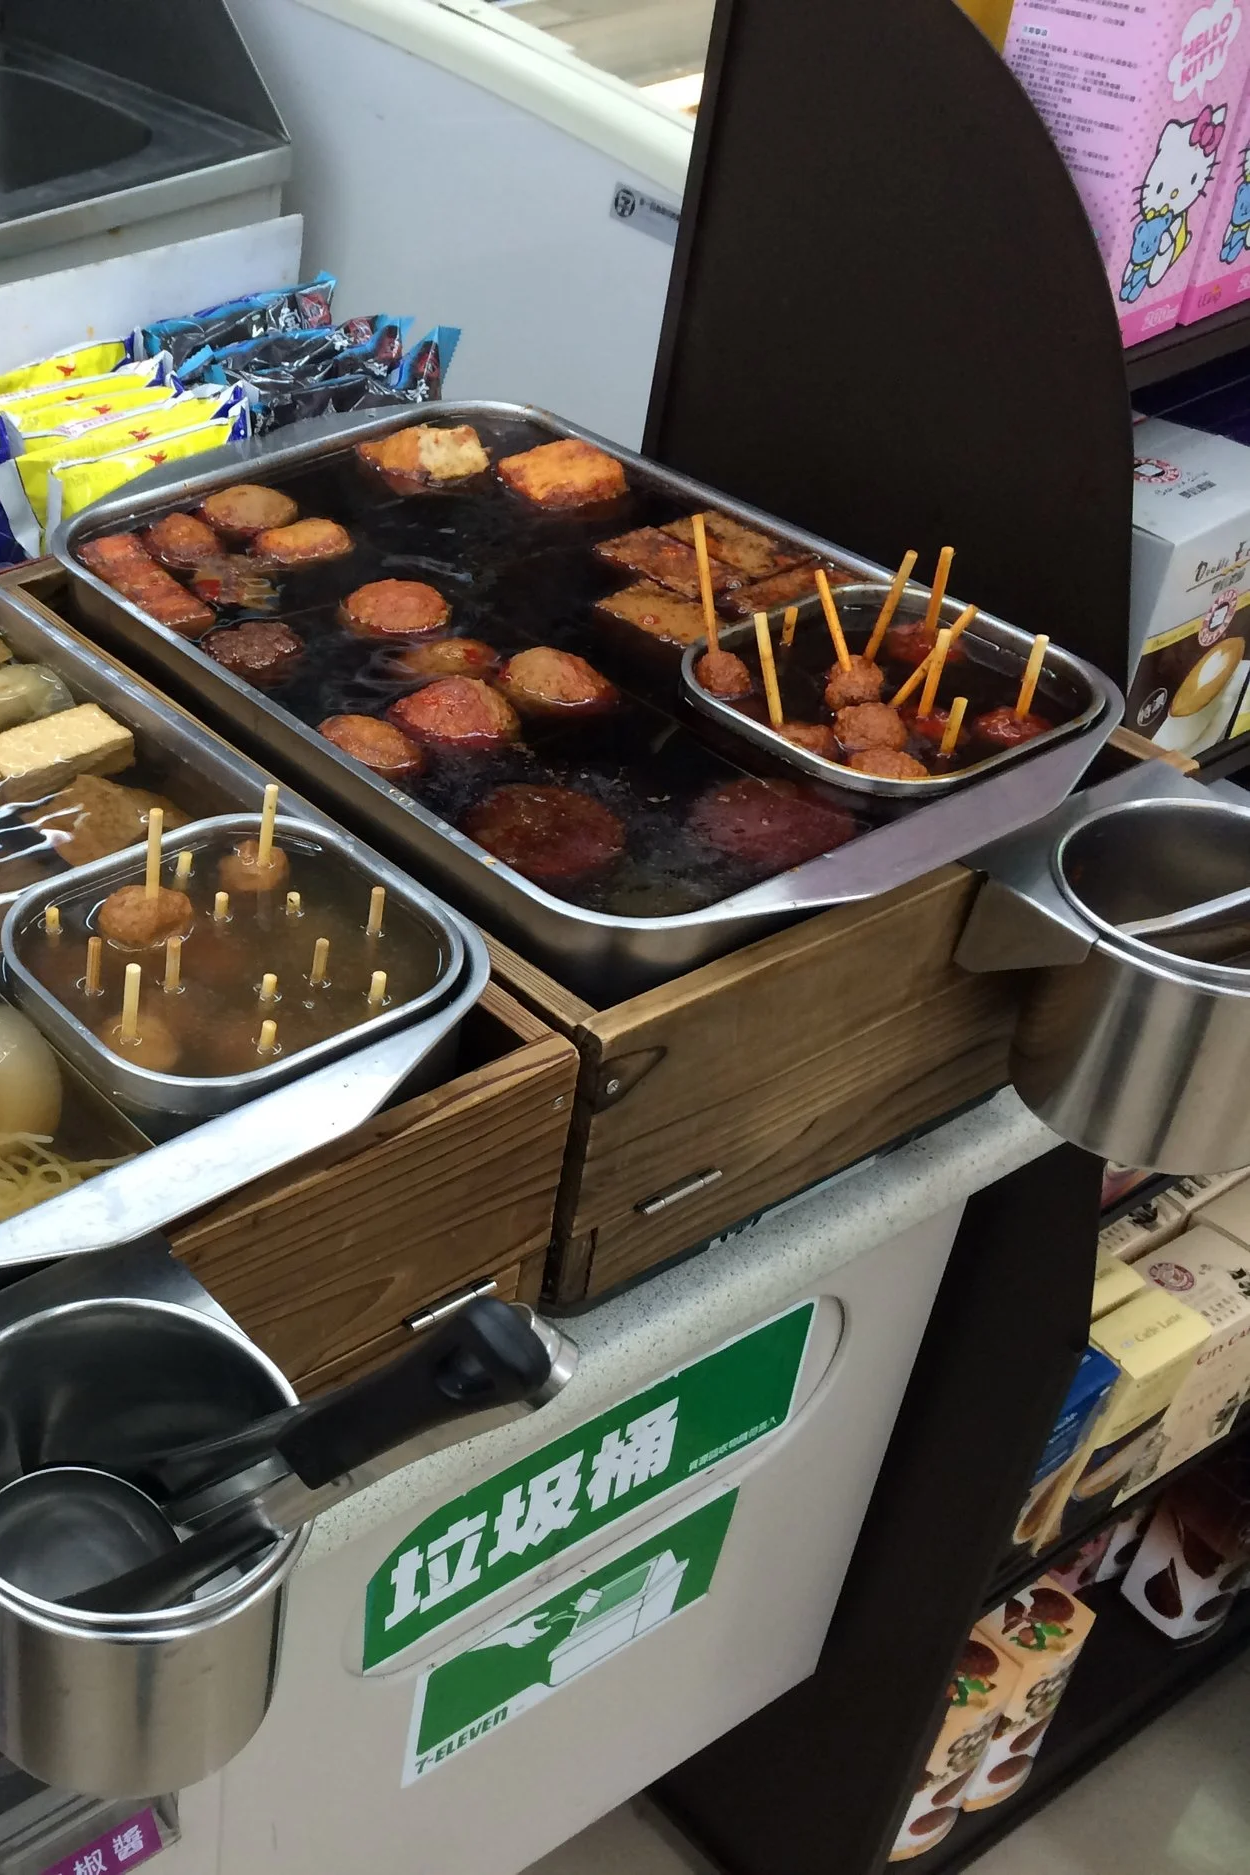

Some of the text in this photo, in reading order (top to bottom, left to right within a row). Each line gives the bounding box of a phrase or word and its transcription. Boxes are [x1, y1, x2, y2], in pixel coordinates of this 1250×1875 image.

[1180, 36, 1229, 88] KITTY
[1181, 12, 1233, 63] HELLO
[385, 1397, 679, 1631] 垃圾桶
[53, 1824, 145, 1875] 椒醬
